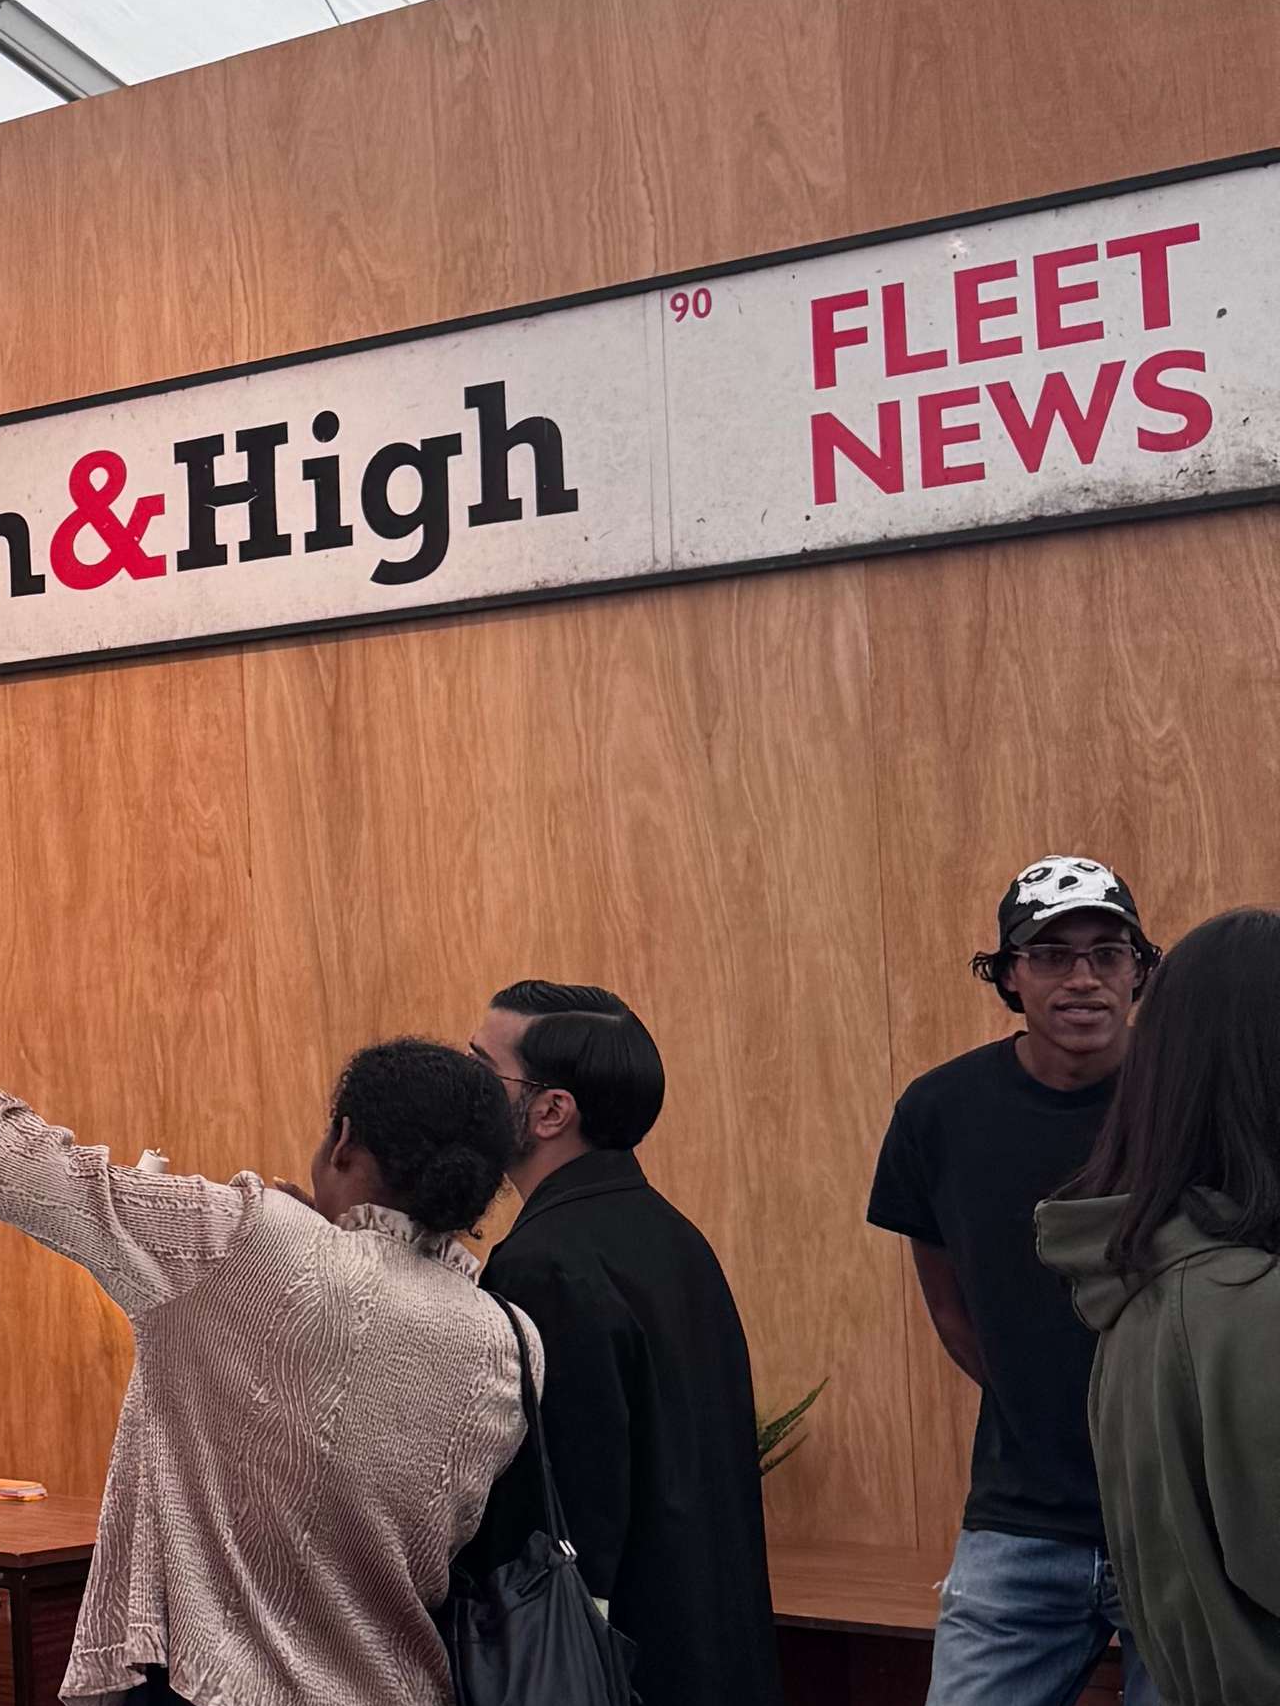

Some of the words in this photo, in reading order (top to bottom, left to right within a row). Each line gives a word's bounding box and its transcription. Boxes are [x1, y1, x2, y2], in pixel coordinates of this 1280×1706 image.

[670, 287, 712, 323] 90
[811, 222, 1201, 390] FLEET
[811, 348, 1214, 506] NEWS
